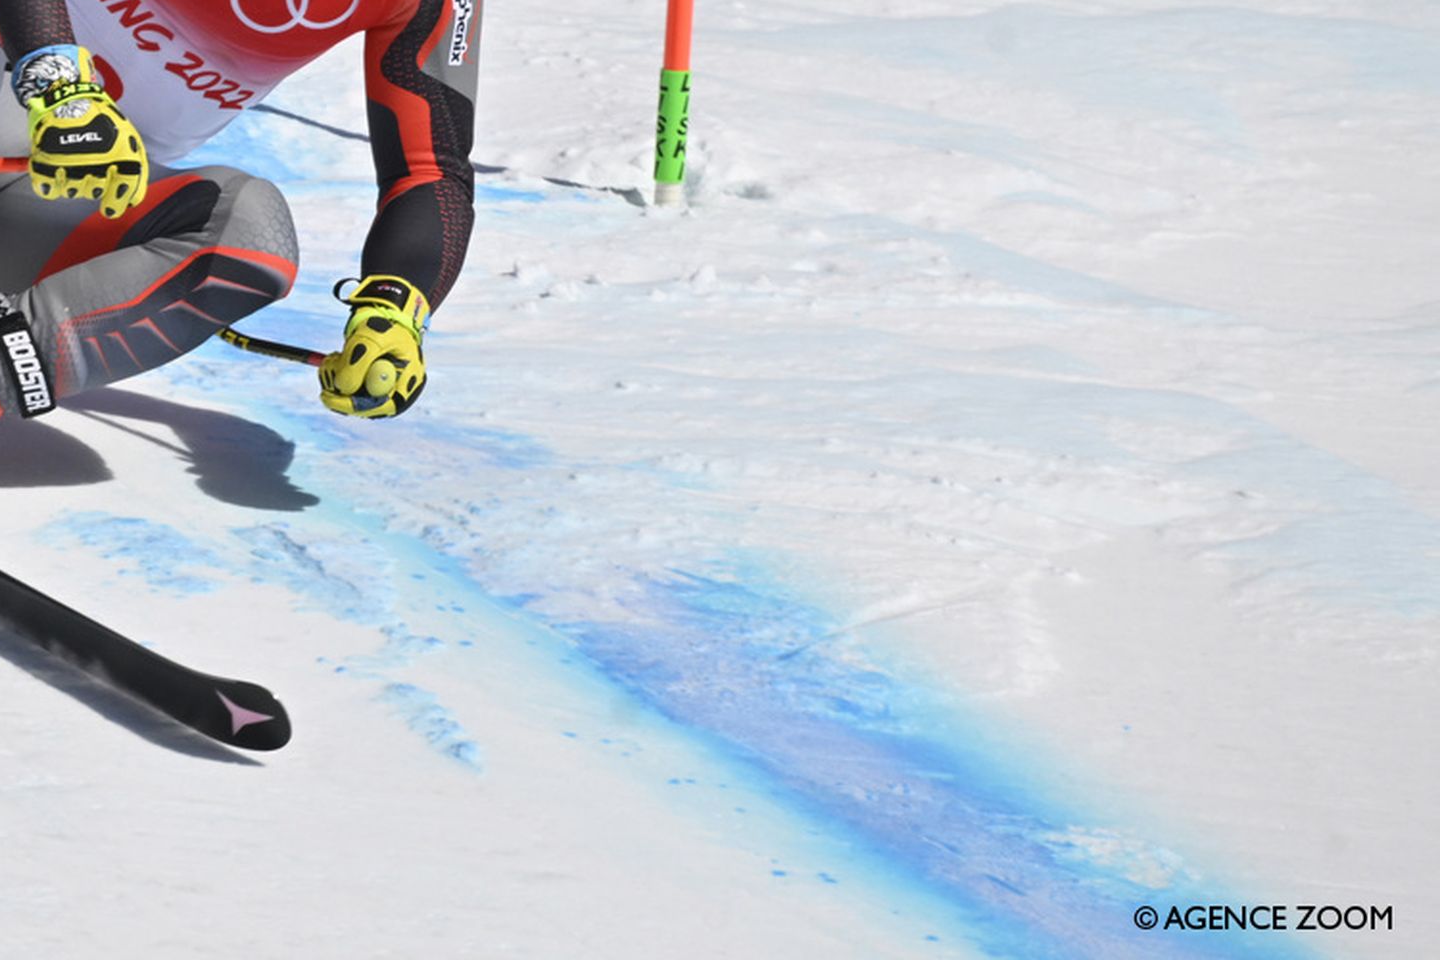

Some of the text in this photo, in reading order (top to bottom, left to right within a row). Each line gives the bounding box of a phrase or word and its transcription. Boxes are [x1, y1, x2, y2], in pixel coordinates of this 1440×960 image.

[164, 50, 255, 110] 2022
[59, 131, 103, 145] LEVEL
[2, 329, 51, 413] BOOSTER
